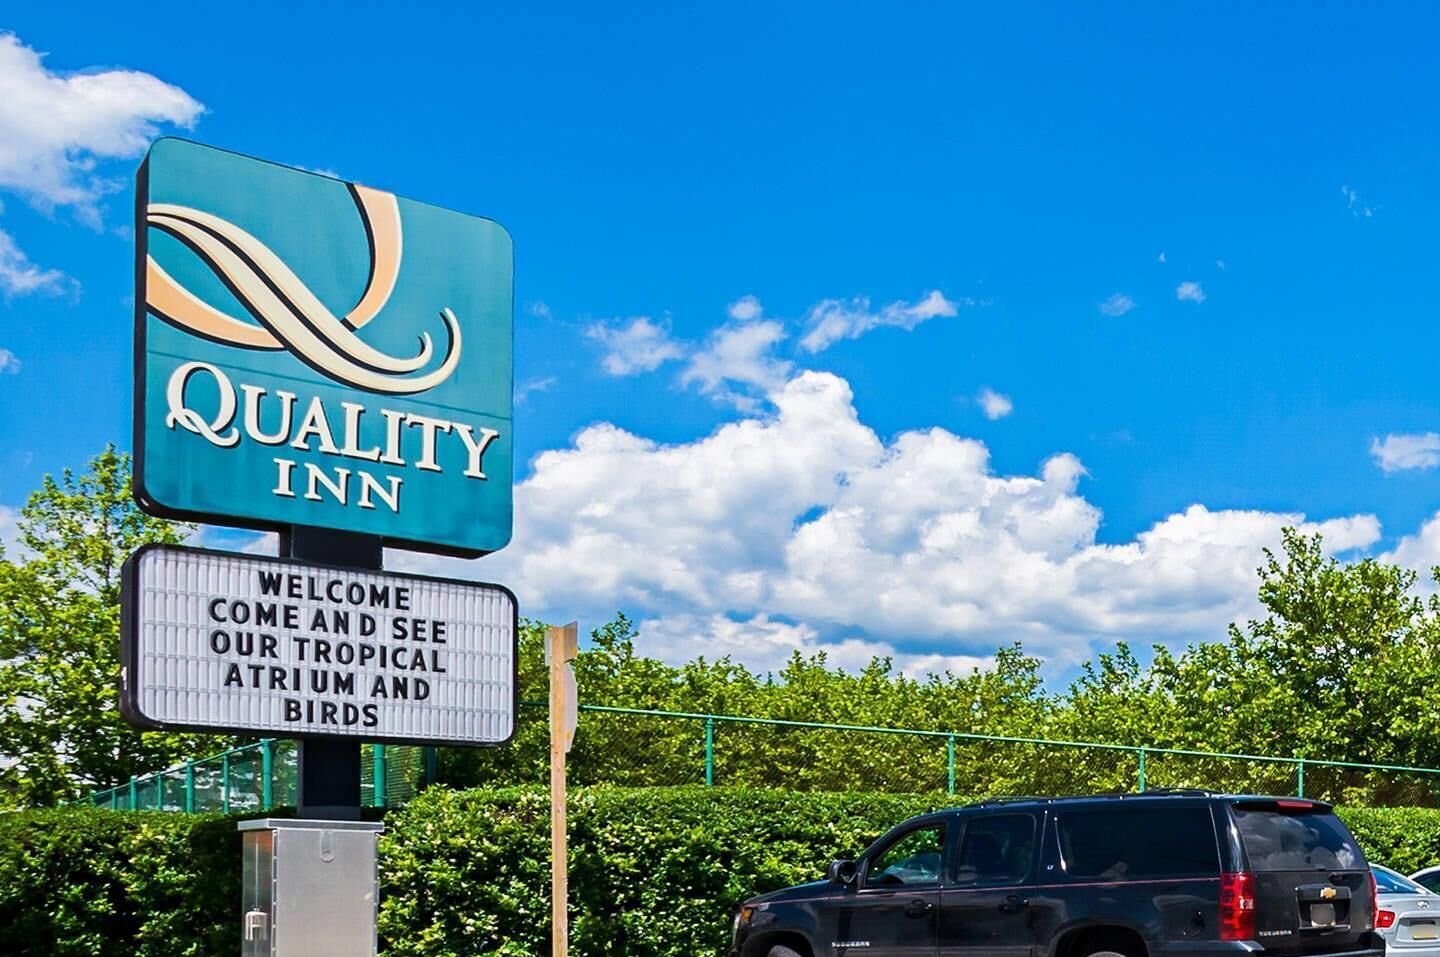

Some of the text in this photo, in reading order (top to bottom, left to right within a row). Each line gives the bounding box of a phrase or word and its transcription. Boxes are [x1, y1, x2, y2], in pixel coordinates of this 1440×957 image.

[166, 361, 499, 479] QUALITY
[272, 458, 403, 513] INN
[258, 570, 410, 611] WELCOME
[208, 598, 447, 644] COME AND SEE
[209, 629, 447, 673] OUR TROPICAL
[223, 662, 430, 701] ATRIUM AND
[284, 698, 379, 728] BIRDS
